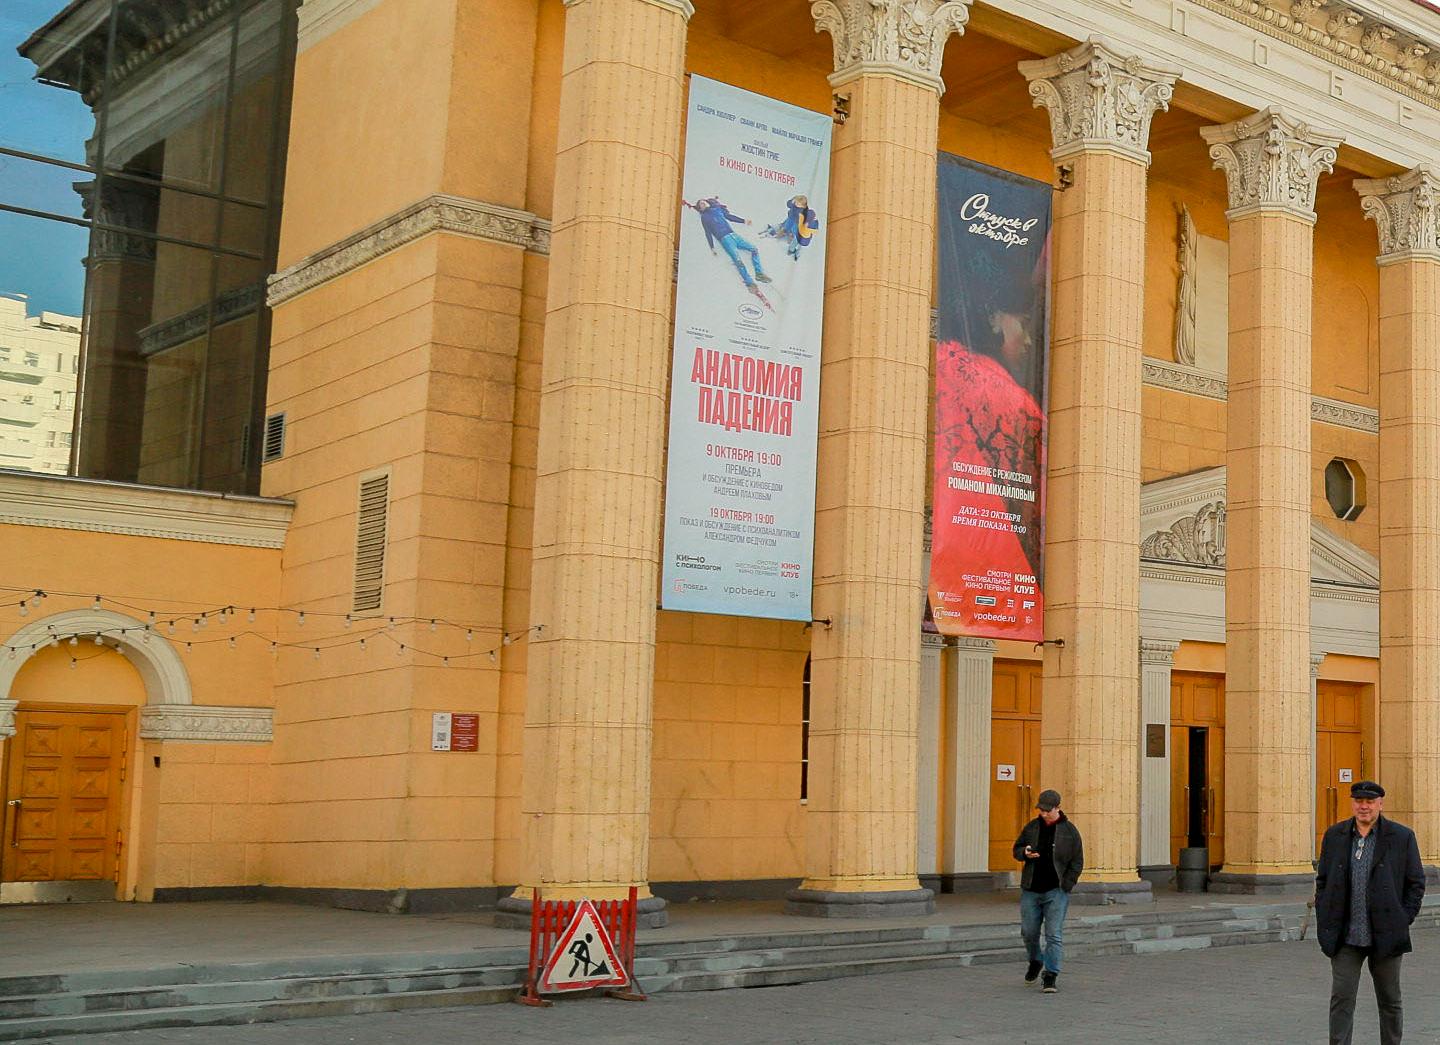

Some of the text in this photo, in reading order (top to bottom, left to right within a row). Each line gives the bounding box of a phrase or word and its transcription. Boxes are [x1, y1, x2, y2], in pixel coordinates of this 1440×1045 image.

[766, 149, 780, 161] ТРИЕ
[719, 156, 795, 186] В КИНО С 19 ОКТЯБРЯ
[961, 193, 1038, 231] Отпуск в
[968, 223, 1028, 248] октябре
[691, 347, 802, 401] АНАТОМИЯ
[698, 387, 793, 436] ПАДЕНИЯ
[706, 444, 782, 466] 9 ОКТЯБРЯ 19:00
[725, 463, 761, 478] ПРЕМЬЕРА
[952, 461, 1032, 484] ОБСУЖДЕНИЕ С РЕЖИССЕРОМ
[707, 474, 745, 487] ОБСУЖДЕНИЕ
[750, 480, 783, 491] КИНОВЕДОМ
[948, 477, 1035, 502] РОМАНОМ МИХАЙЛОВЫМ
[713, 486, 772, 500] АНДРЕЕМ ПЛАХОВЫМ
[710, 507, 775, 524] 19 ОКТЯБРЯ 19:00
[959, 506, 1021, 523] ДАТА: 23 ОКТЯБРЯ
[680, 517, 698, 527] ПОКАЗ
[699, 518, 703, 527] И
[704, 519, 742, 532] ОБСУЖДЕНИЕ
[952, 515, 1026, 534] ВРЕМЯ ПОКАЗА: 19:00
[704, 531, 745, 543] АЛЕКСАНДРОМ
[681, 562, 722, 571] психологом
[986, 570, 1012, 578] СМОТРИ
[781, 571, 800, 579] КЛУБ
[961, 574, 1012, 586] ФЕСТИВАЛЬНОЕ
[1014, 573, 1036, 584] КИНО
[723, 585, 776, 598] vpobede.ru
[965, 581, 983, 590] КИНО
[1013, 585, 1035, 595] КЛУБ
[973, 612, 1016, 623] vpobede.ru
